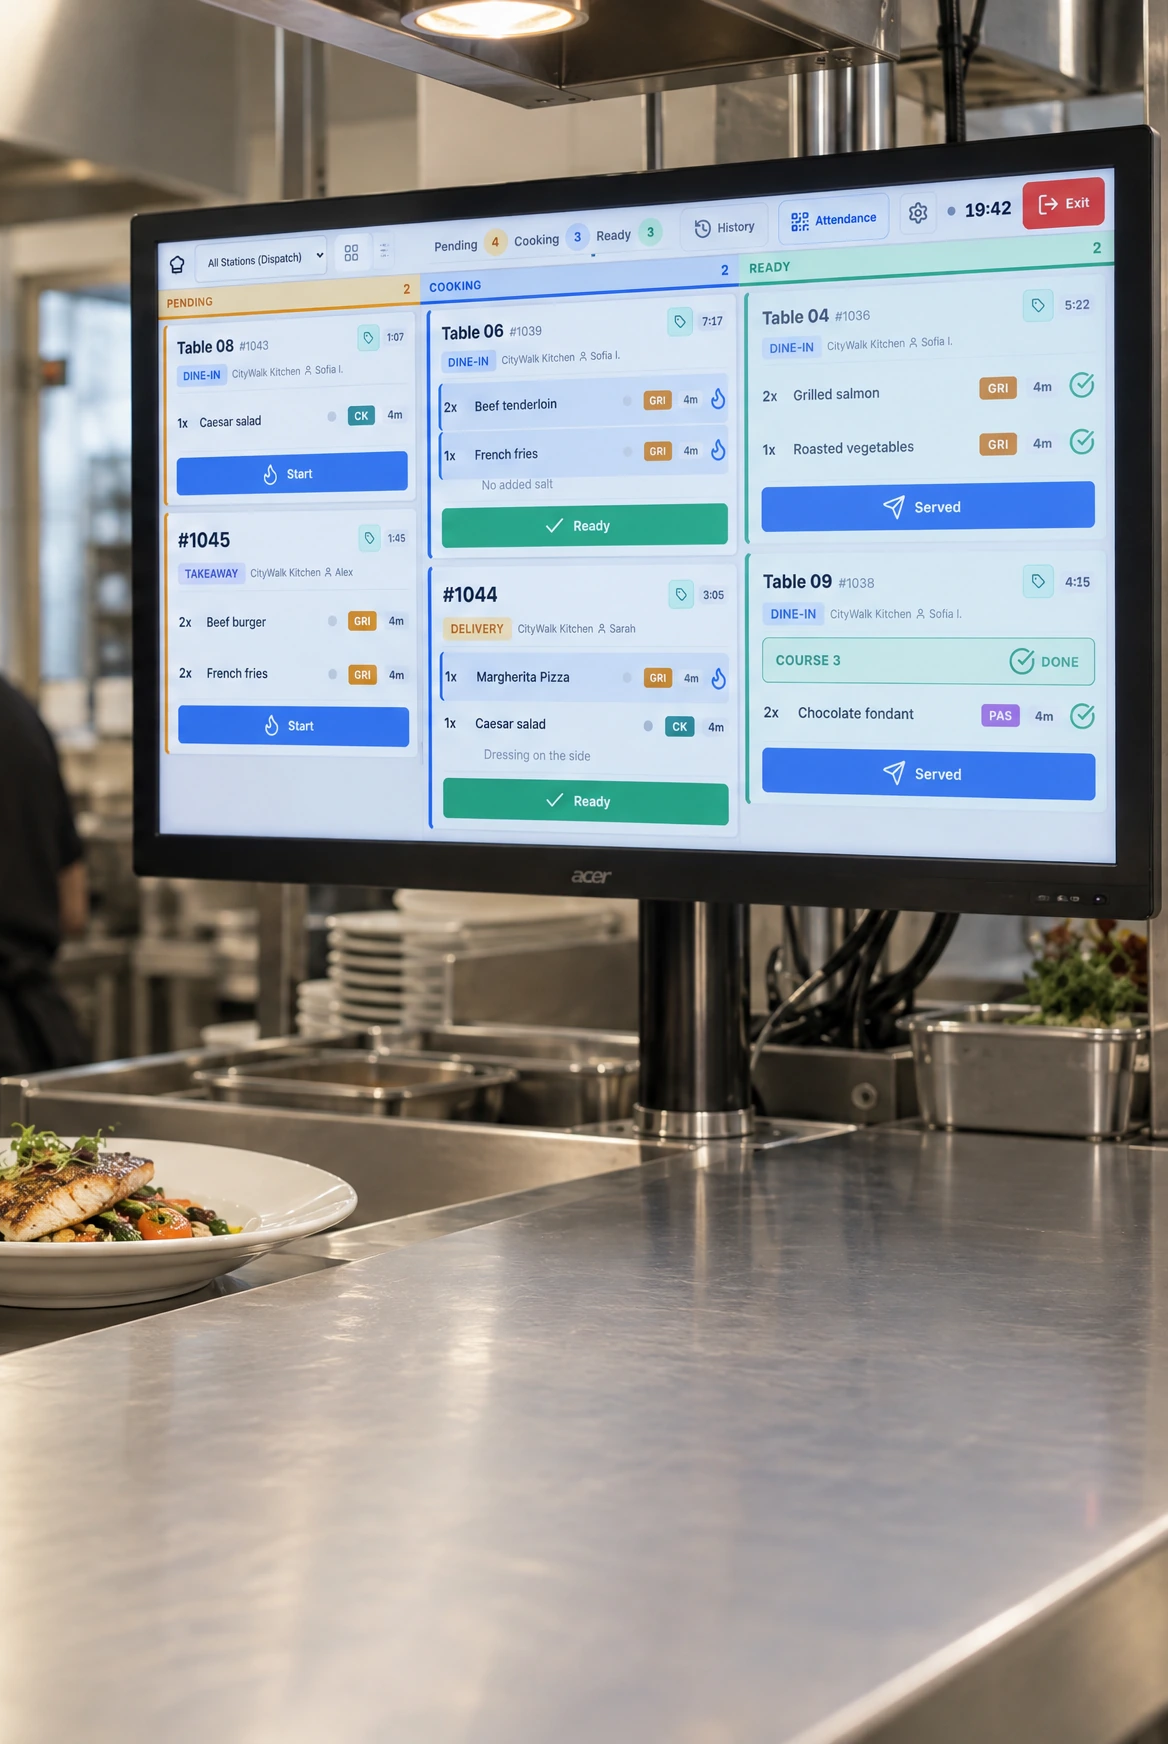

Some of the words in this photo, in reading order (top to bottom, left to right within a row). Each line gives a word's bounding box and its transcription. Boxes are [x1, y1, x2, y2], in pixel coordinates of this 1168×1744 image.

[1066, 197, 1089, 209] Exit
[966, 201, 1011, 217] 19:42
[816, 214, 876, 225] Attendance
[718, 223, 754, 233] History
[515, 235, 559, 246] Cooking
[575, 232, 581, 242] 3
[597, 230, 631, 242] Ready
[648, 227, 654, 237] 3
[435, 240, 477, 252] Pending
[492, 237, 499, 246] 4
[1093, 242, 1101, 253] 2
[208, 258, 218, 267] All
[221, 258, 255, 266] Stations
[258, 252, 301, 266] (Dispatch)
[722, 265, 728, 275] 2
[750, 262, 790, 273] READY
[404, 284, 410, 294] 2
[430, 280, 481, 292] COOKING
[167, 297, 212, 308] PENDING
[1065, 299, 1089, 310] 5:22
[703, 316, 722, 326] 7:17
[762, 310, 803, 325] Table
[808, 309, 829, 323] 04
[835, 310, 870, 321] #1036
[387, 333, 404, 341] 1:07
[442, 325, 480, 340] Table
[484, 324, 503, 338] 06
[510, 326, 541, 336] #1039
[177, 340, 212, 354] Table
[216, 339, 234, 352] 08
[240, 340, 268, 351] #1043
[770, 342, 813, 353] DINE-IN
[828, 340, 867, 351] CityWalk
[871, 340, 905, 348] Kitchen
[922, 337, 944, 347] Sofia
[449, 357, 488, 367] DINE-IN
[502, 354, 539, 366] CityWalk
[542, 353, 575, 362] Kitchen
[591, 351, 612, 360] Sofia
[184, 370, 220, 380] DINE-IN
[232, 368, 267, 380] CityWalk
[270, 367, 300, 376] Kitchen
[316, 365, 336, 374] Sofia
[988, 383, 1008, 393] GRI
[1033, 382, 1051, 392] 4m
[650, 396, 665, 405] GRI
[684, 395, 697, 404] 4m
[763, 391, 777, 402] 2x
[794, 389, 832, 401] Grilled
[837, 388, 879, 399] salmon
[444, 402, 457, 412] 2x
[475, 400, 499, 411] Beef
[502, 399, 556, 410] tenderloin
[355, 412, 368, 420] CK
[388, 410, 402, 419] 4m
[178, 418, 187, 428] 1x
[200, 417, 233, 427] Caesar
[236, 415, 261, 426] salad
[763, 444, 775, 455] 1x
[794, 442, 842, 454] Roasted
[847, 441, 914, 456] vegetables
[988, 440, 1008, 449] GRI
[1033, 439, 1052, 448] 4m
[444, 451, 455, 461] 1x
[475, 449, 511, 460] French
[514, 448, 538, 459] fries
[650, 447, 666, 455] GRI
[684, 446, 698, 455] 4m
[287, 469, 313, 479] Start
[482, 480, 496, 490] No
[499, 479, 531, 489] added
[535, 479, 553, 489] salt
[915, 501, 960, 513] Served
[574, 520, 610, 533] Ready
[178, 532, 230, 548] #1045
[388, 534, 405, 542] 1:45
[185, 569, 238, 578] TAKEAWAY
[251, 568, 287, 579] CityWalk
[289, 568, 320, 577] Kitchen
[335, 568, 353, 576] Alex
[763, 574, 806, 588] Table
[811, 574, 832, 588] 09
[839, 578, 874, 588] #1038
[1066, 577, 1090, 587] 4:15
[443, 586, 497, 602] #1044
[704, 590, 724, 599] 3:05
[771, 609, 816, 619] DINE-IN
[831, 609, 872, 620] CityWalk
[876, 609, 911, 618] Kitchen
[930, 609, 953, 618] Sofia
[179, 617, 191, 627] 2x
[207, 617, 229, 627] Beef
[233, 617, 266, 629] burger
[354, 617, 370, 625] GRI
[389, 617, 403, 625] 4m
[451, 624, 503, 633] DELIVERY
[518, 624, 557, 635] CityWalk
[560, 624, 593, 633] Kitchen
[610, 624, 635, 633] Sarah
[776, 655, 828, 665] COURSE
[833, 655, 840, 666] 3
[1042, 657, 1078, 667] DONE
[180, 668, 191, 678] 2x
[207, 668, 241, 678] French
[245, 668, 267, 678] fries
[355, 670, 370, 679] GRI
[389, 671, 404, 679] 4m
[445, 671, 456, 682] 1x
[477, 671, 536, 684] Margherita
[541, 671, 569, 682] Pizza
[650, 674, 666, 682] GRI
[684, 674, 698, 682] 4m
[764, 707, 778, 718] 2x
[799, 707, 861, 719] Chocolate
[865, 707, 914, 719] fondant
[990, 711, 1012, 720] PAS
[1035, 711, 1053, 721] 4m
[288, 721, 314, 731] Start
[445, 718, 456, 728] 1x
[476, 718, 514, 729] Caesar
[517, 719, 545, 729] salad
[673, 722, 687, 731] CK
[709, 723, 724, 732] 4m
[485, 749, 529, 762] Dressing
[533, 752, 545, 760] on
[549, 750, 566, 760] the
[569, 751, 590, 761] side
[916, 768, 961, 780] Served
[574, 796, 610, 810] Ready
[572, 871, 612, 884] acer
